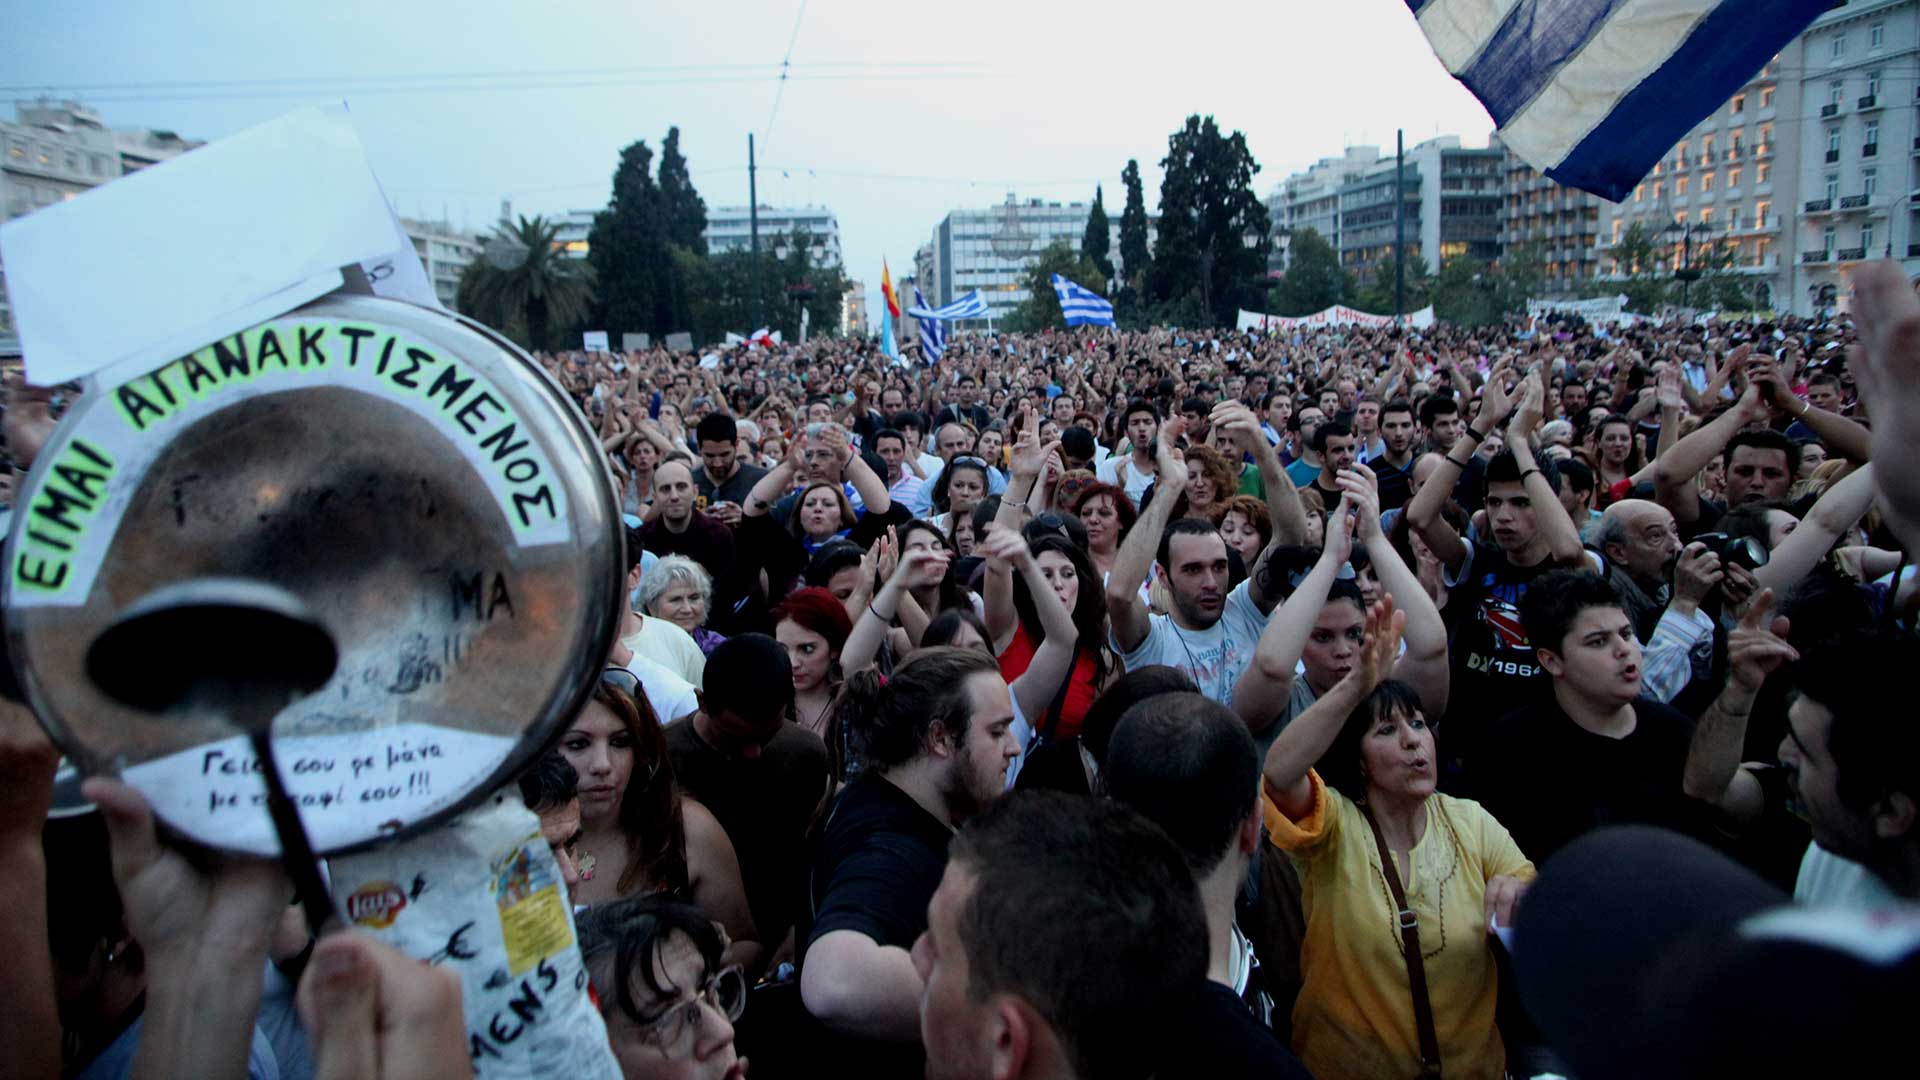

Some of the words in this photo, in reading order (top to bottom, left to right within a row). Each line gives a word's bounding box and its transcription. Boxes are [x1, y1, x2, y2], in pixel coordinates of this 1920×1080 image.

[18, 440, 113, 589] ΕΙΜΑΙ
[117, 326, 557, 528] ΑΓΑΝΑΚΤΙΣΜΕΝΟΣ
[292, 756, 335, 774] σου
